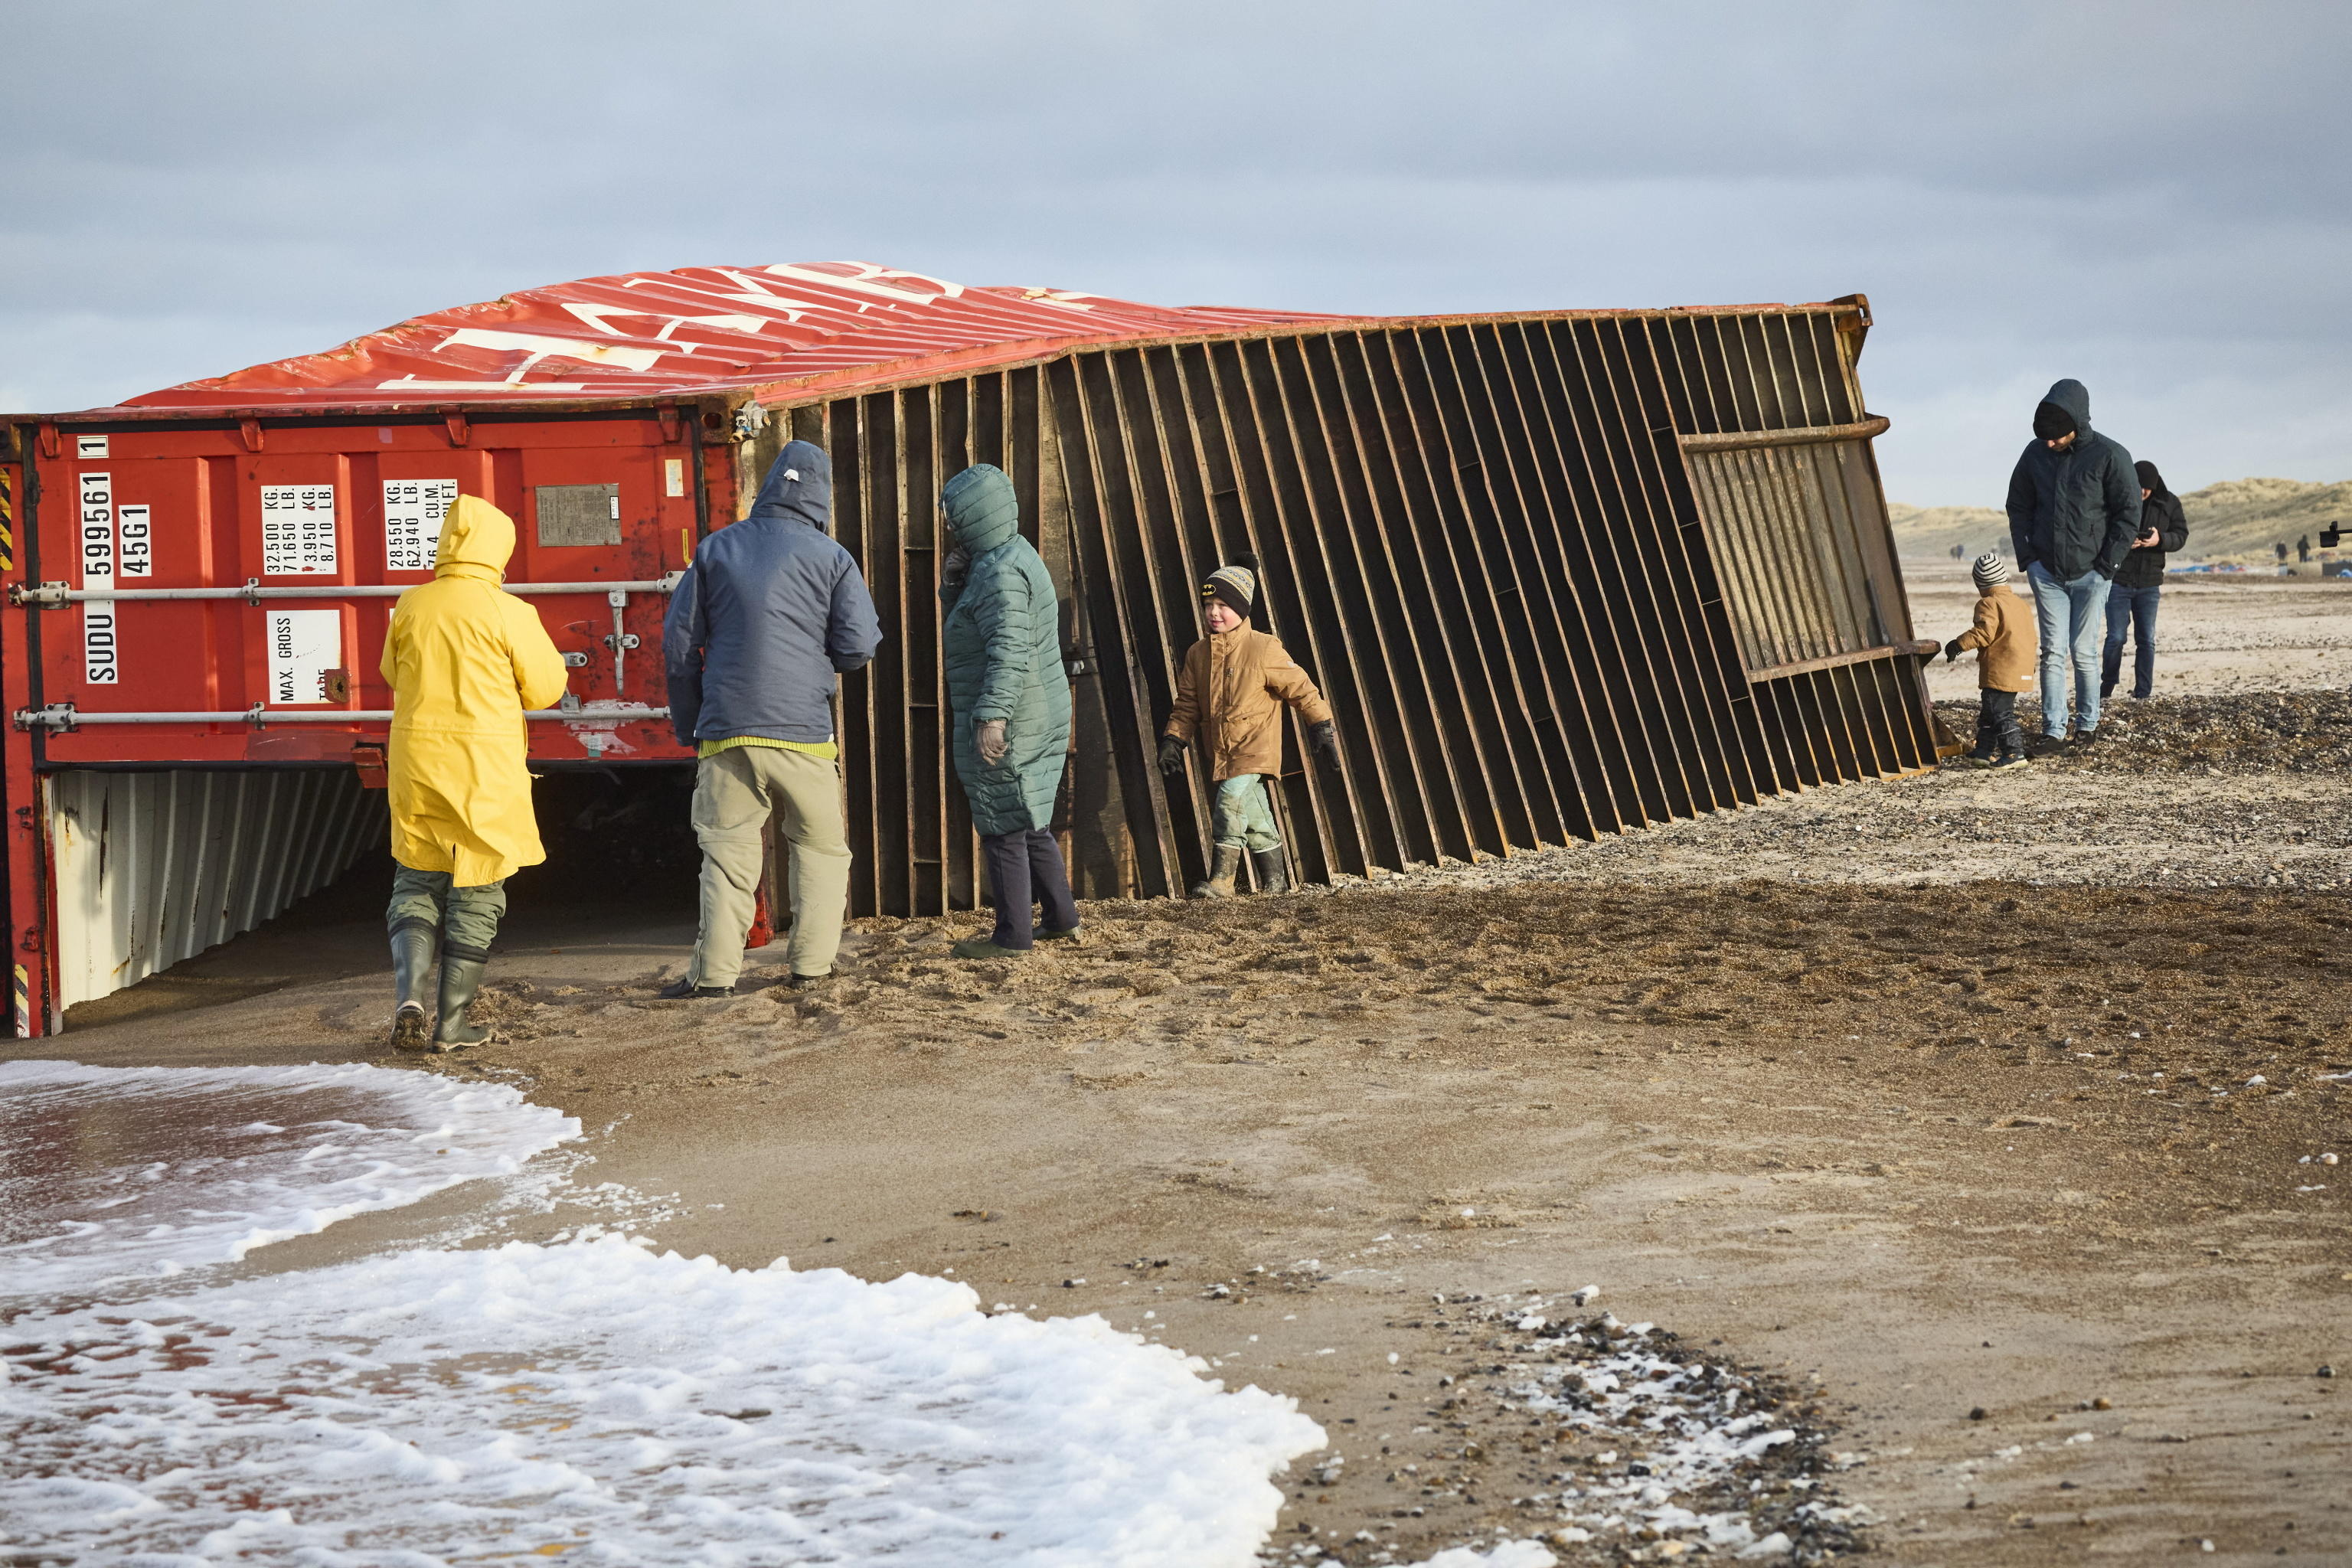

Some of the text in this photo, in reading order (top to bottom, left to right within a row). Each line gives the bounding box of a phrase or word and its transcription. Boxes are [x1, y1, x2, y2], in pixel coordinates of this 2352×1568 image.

[264, 488, 278, 509] KG.
[281, 488, 295, 509] LB.
[302, 488, 315, 510] KG.
[318, 488, 332, 508] LB.
[387, 482, 400, 504] KG.
[403, 482, 418, 504] LB.
[425, 484, 439, 518] CU.M.
[121, 508, 149, 573] 45G1
[80, 443, 116, 681] SUDU 599561 1
[276, 618, 294, 701] MAX. GROSS
